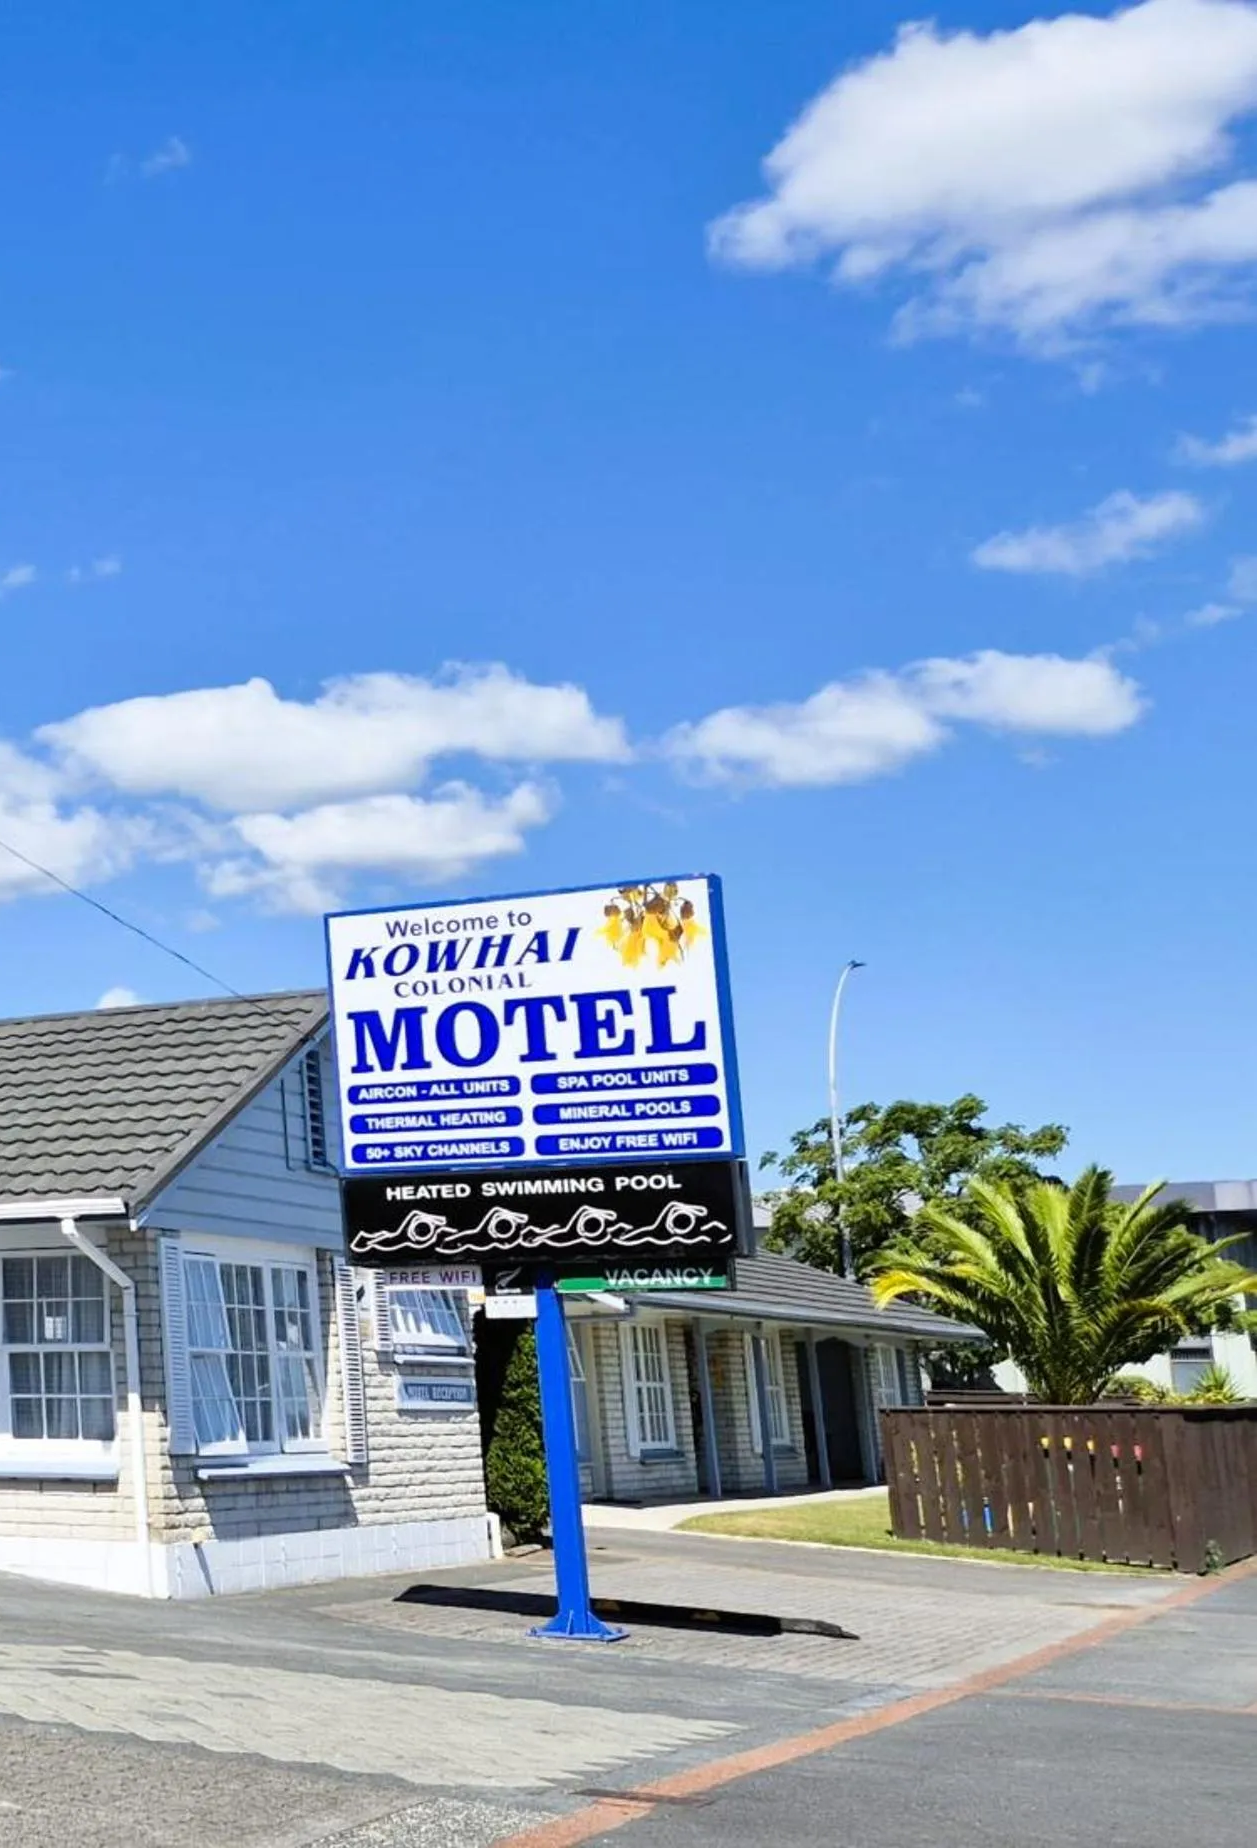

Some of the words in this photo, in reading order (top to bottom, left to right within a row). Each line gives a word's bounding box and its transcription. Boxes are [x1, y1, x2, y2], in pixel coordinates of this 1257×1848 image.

[385, 912, 499, 939] Welcome
[508, 910, 532, 927] to
[343, 926, 582, 981] KOWHAI
[393, 972, 533, 999] COLONIAL
[347, 985, 707, 1074] MOTEL
[357, 1085, 418, 1101] AIRCON
[429, 1082, 460, 1097] ALL
[462, 1079, 510, 1094] UNITS
[557, 1075, 589, 1090] SPA
[592, 1073, 637, 1088] POOL
[641, 1069, 690, 1084] UNITS
[559, 1104, 631, 1120] MINERAL
[634, 1100, 691, 1116] POOLS
[365, 1114, 437, 1131] THERMAL
[440, 1111, 507, 1127] HEATING
[366, 1147, 391, 1160] 50+
[394, 1145, 425, 1159] SKY
[427, 1141, 510, 1157] CHANNELS
[558, 1135, 612, 1151] ENJOY
[616, 1133, 659, 1149] FREE
[385, 1183, 471, 1202] HEATED
[481, 1177, 605, 1198] SWIMMING
[615, 1174, 683, 1192] POOL
[389, 1271, 432, 1284] FREE
[439, 1270, 478, 1284] WIFI
[605, 1267, 714, 1286] VACANCY
